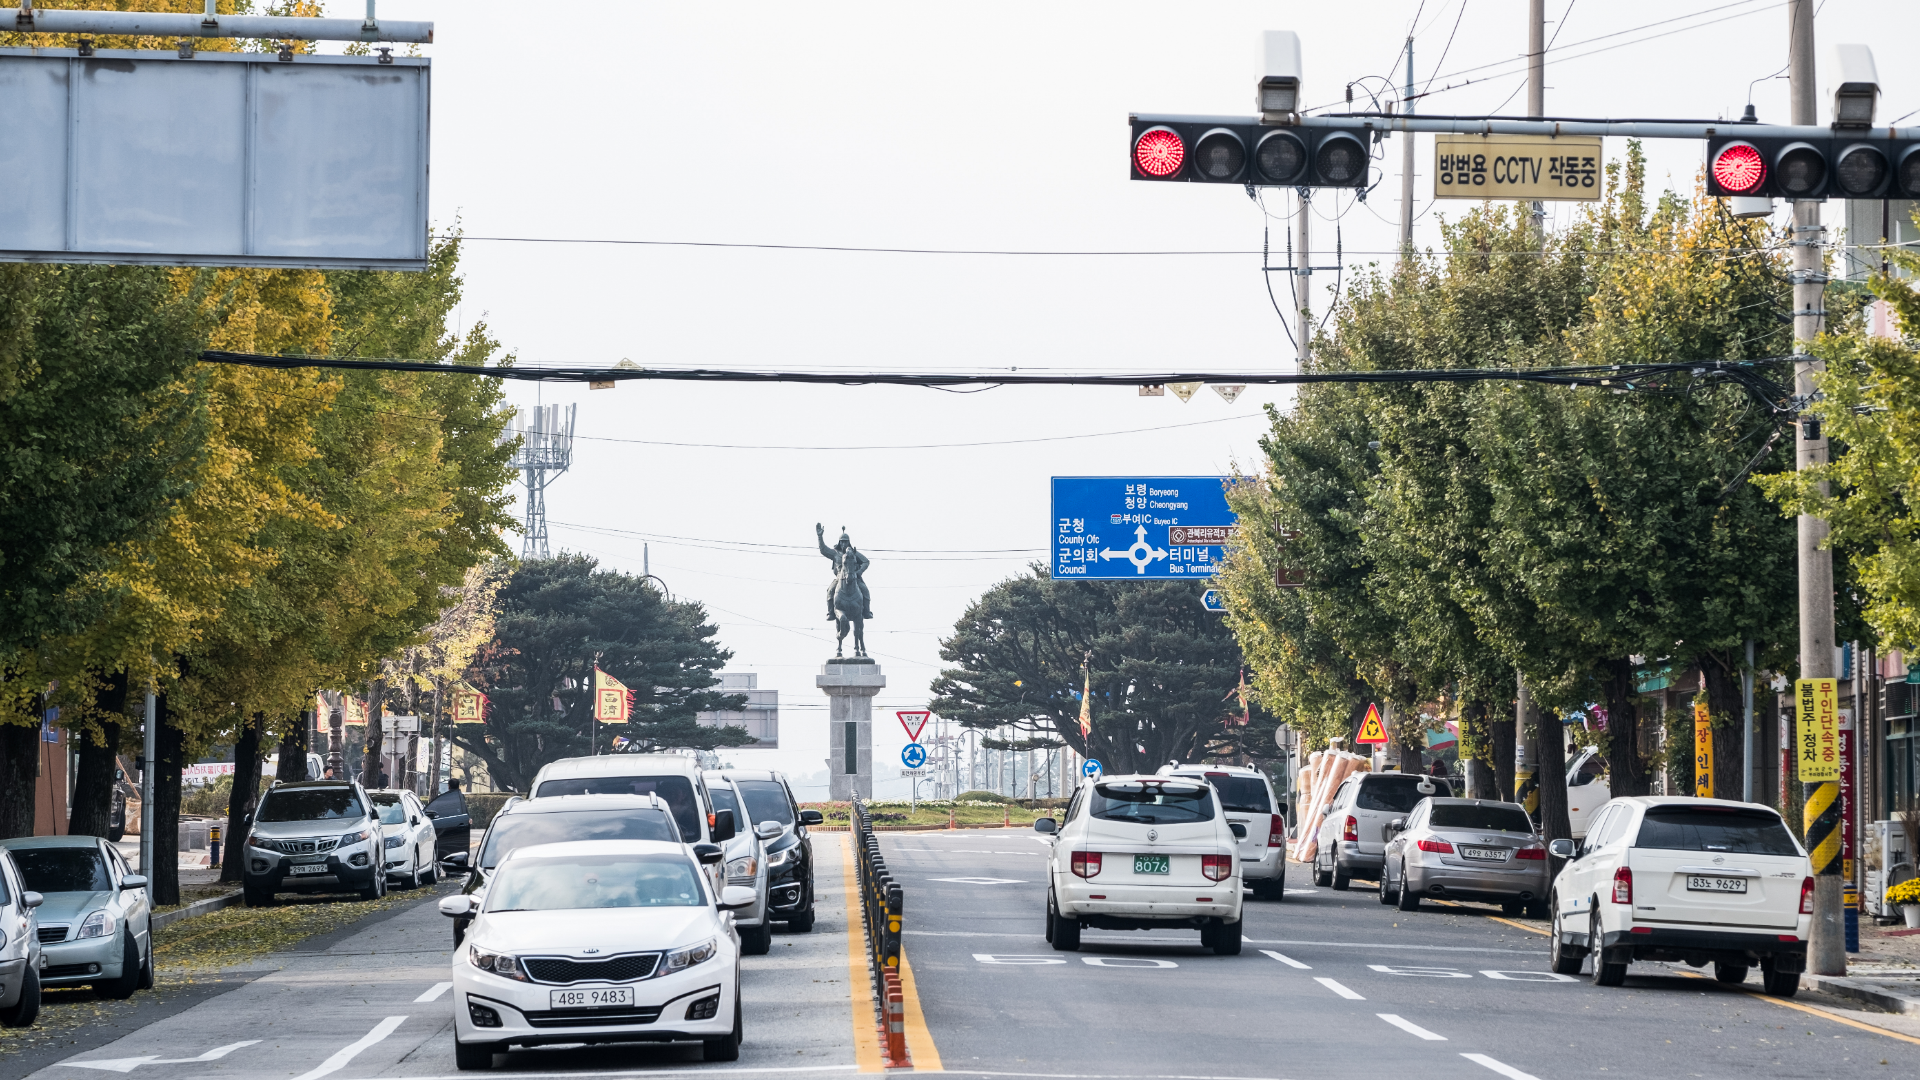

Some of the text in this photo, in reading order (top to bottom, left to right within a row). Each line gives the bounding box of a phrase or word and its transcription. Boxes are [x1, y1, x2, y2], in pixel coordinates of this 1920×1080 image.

[1440, 154, 1596, 188] 방범용 CCTV 작동중
[1124, 483, 1179, 498] 보령 Boryeong
[1124, 497, 1189, 511] 청양 Cheongyang
[1058, 518, 1085, 534] 군청
[1153, 518, 1170, 526] Buyeo
[1058, 534, 1100, 546] County Ofc
[1058, 548, 1098, 563] 군의회
[1169, 547, 1209, 562] 터미널
[1058, 564, 1087, 575] Council
[1169, 564, 1184, 574] Bus
[1800, 682, 1817, 763] 불법주·정차
[1819, 682, 1835, 762] 무인단속중
[1484, 850, 1502, 859] 6357
[308, 865, 325, 873] 2692
[1135, 861, 1168, 873] 8076
[1693, 878, 1742, 890] 83노 9629
[971, 953, 1180, 969] 50
[1366, 964, 1581, 983] 50
[558, 990, 626, 1005] 48모 9483
